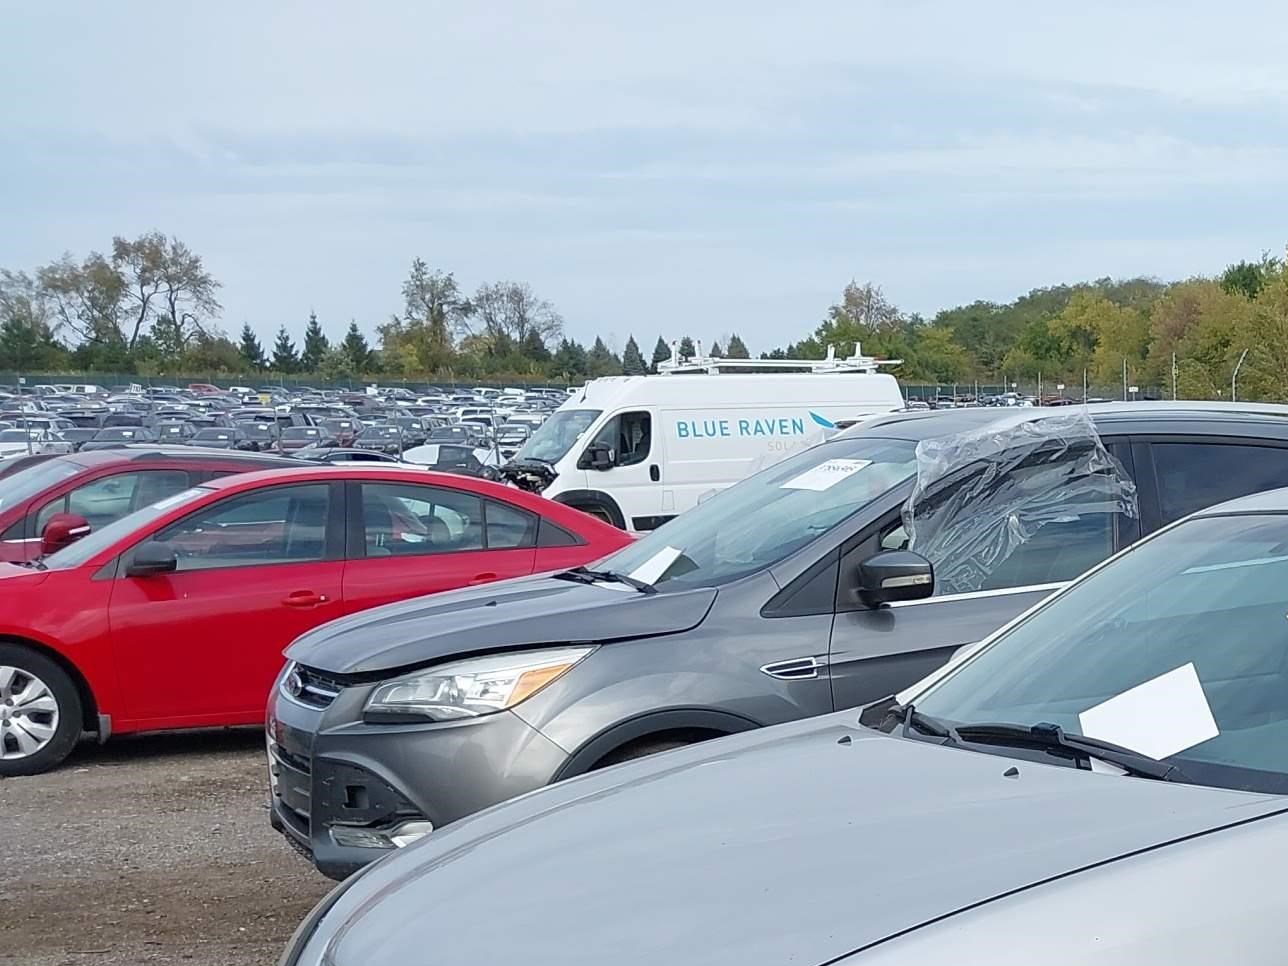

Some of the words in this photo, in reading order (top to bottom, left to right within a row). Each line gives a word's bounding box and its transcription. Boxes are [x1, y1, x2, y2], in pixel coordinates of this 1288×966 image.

[677, 420, 731, 438] BLUE
[739, 418, 805, 436] RAVEN
[767, 439, 804, 452] SOL
